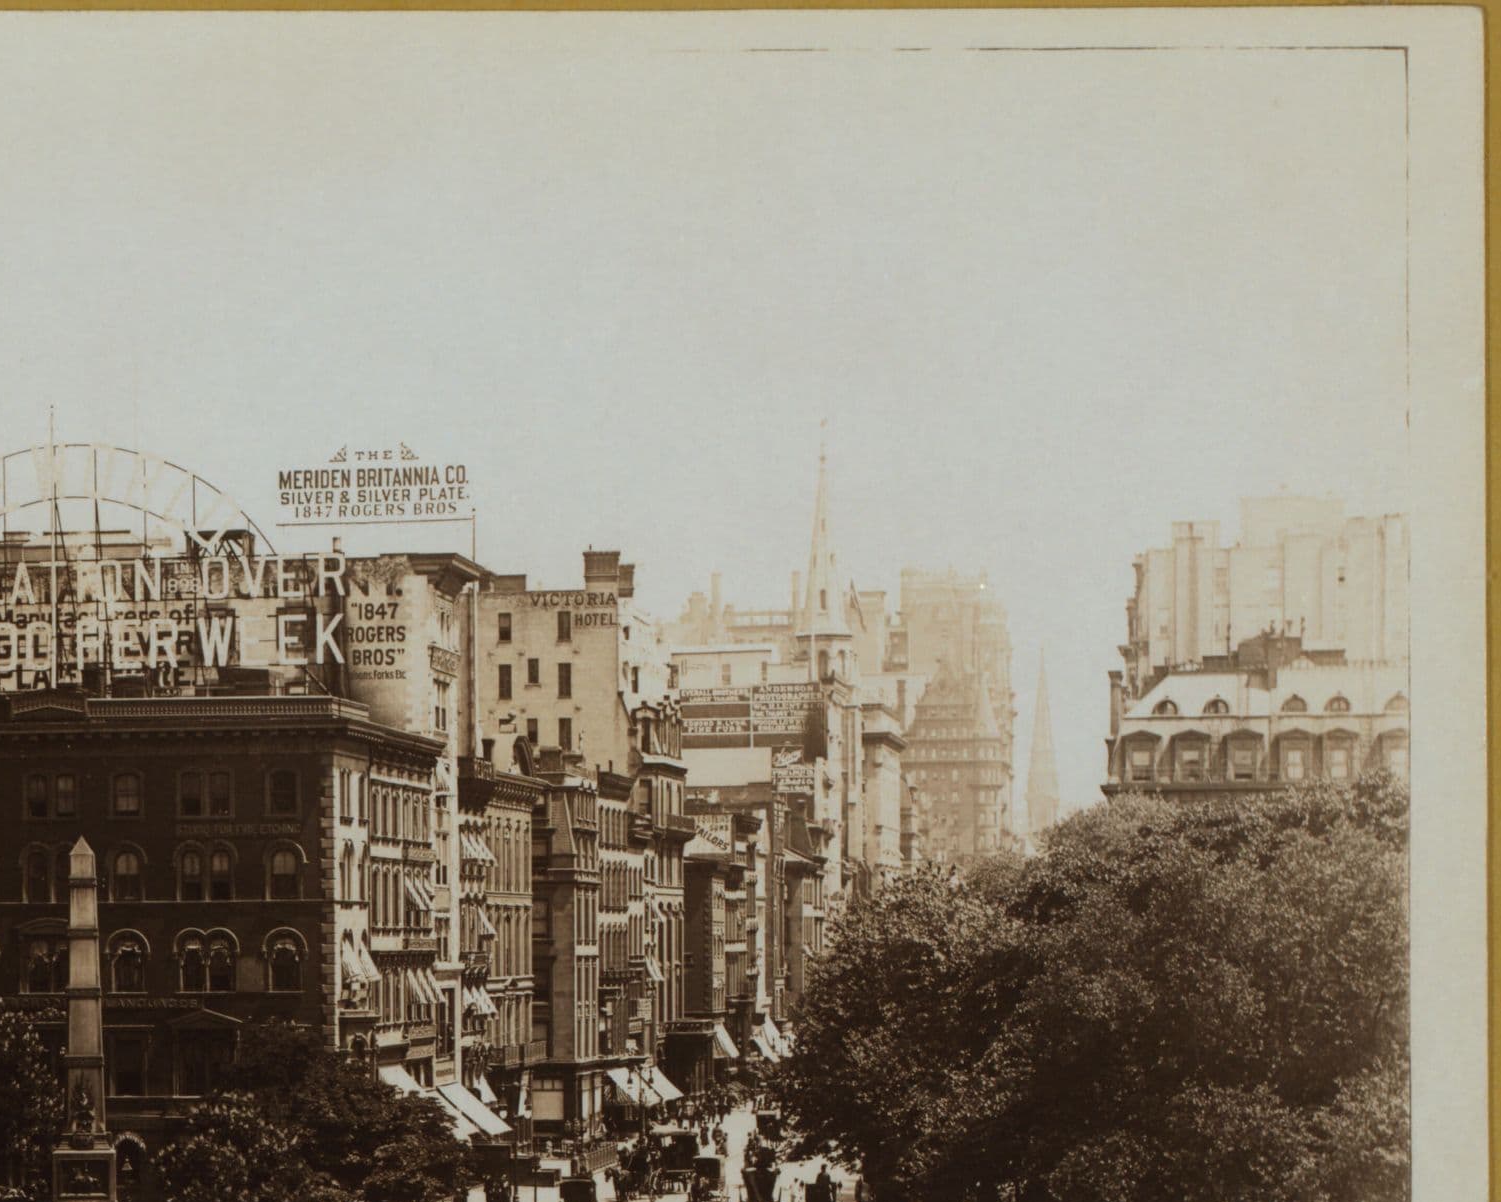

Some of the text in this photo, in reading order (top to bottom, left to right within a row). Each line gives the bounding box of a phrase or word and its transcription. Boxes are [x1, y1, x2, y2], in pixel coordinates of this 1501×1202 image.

[355, 450, 393, 461] THE
[279, 465, 469, 490] MERIDEN BRITANNIA CO.
[281, 486, 470, 505] SILVER & SILVER PLATE.
[294, 501, 458, 518] 1847 ROGERS BROS
[201, 550, 346, 600] OVER
[531, 592, 617, 607] VICTORIA
[350, 602, 399, 620] "1847
[573, 613, 619, 626] HOTEL
[197, 610, 346, 669] WEEK
[347, 625, 406, 643] ROGERS
[352, 648, 405, 666] BROS"
